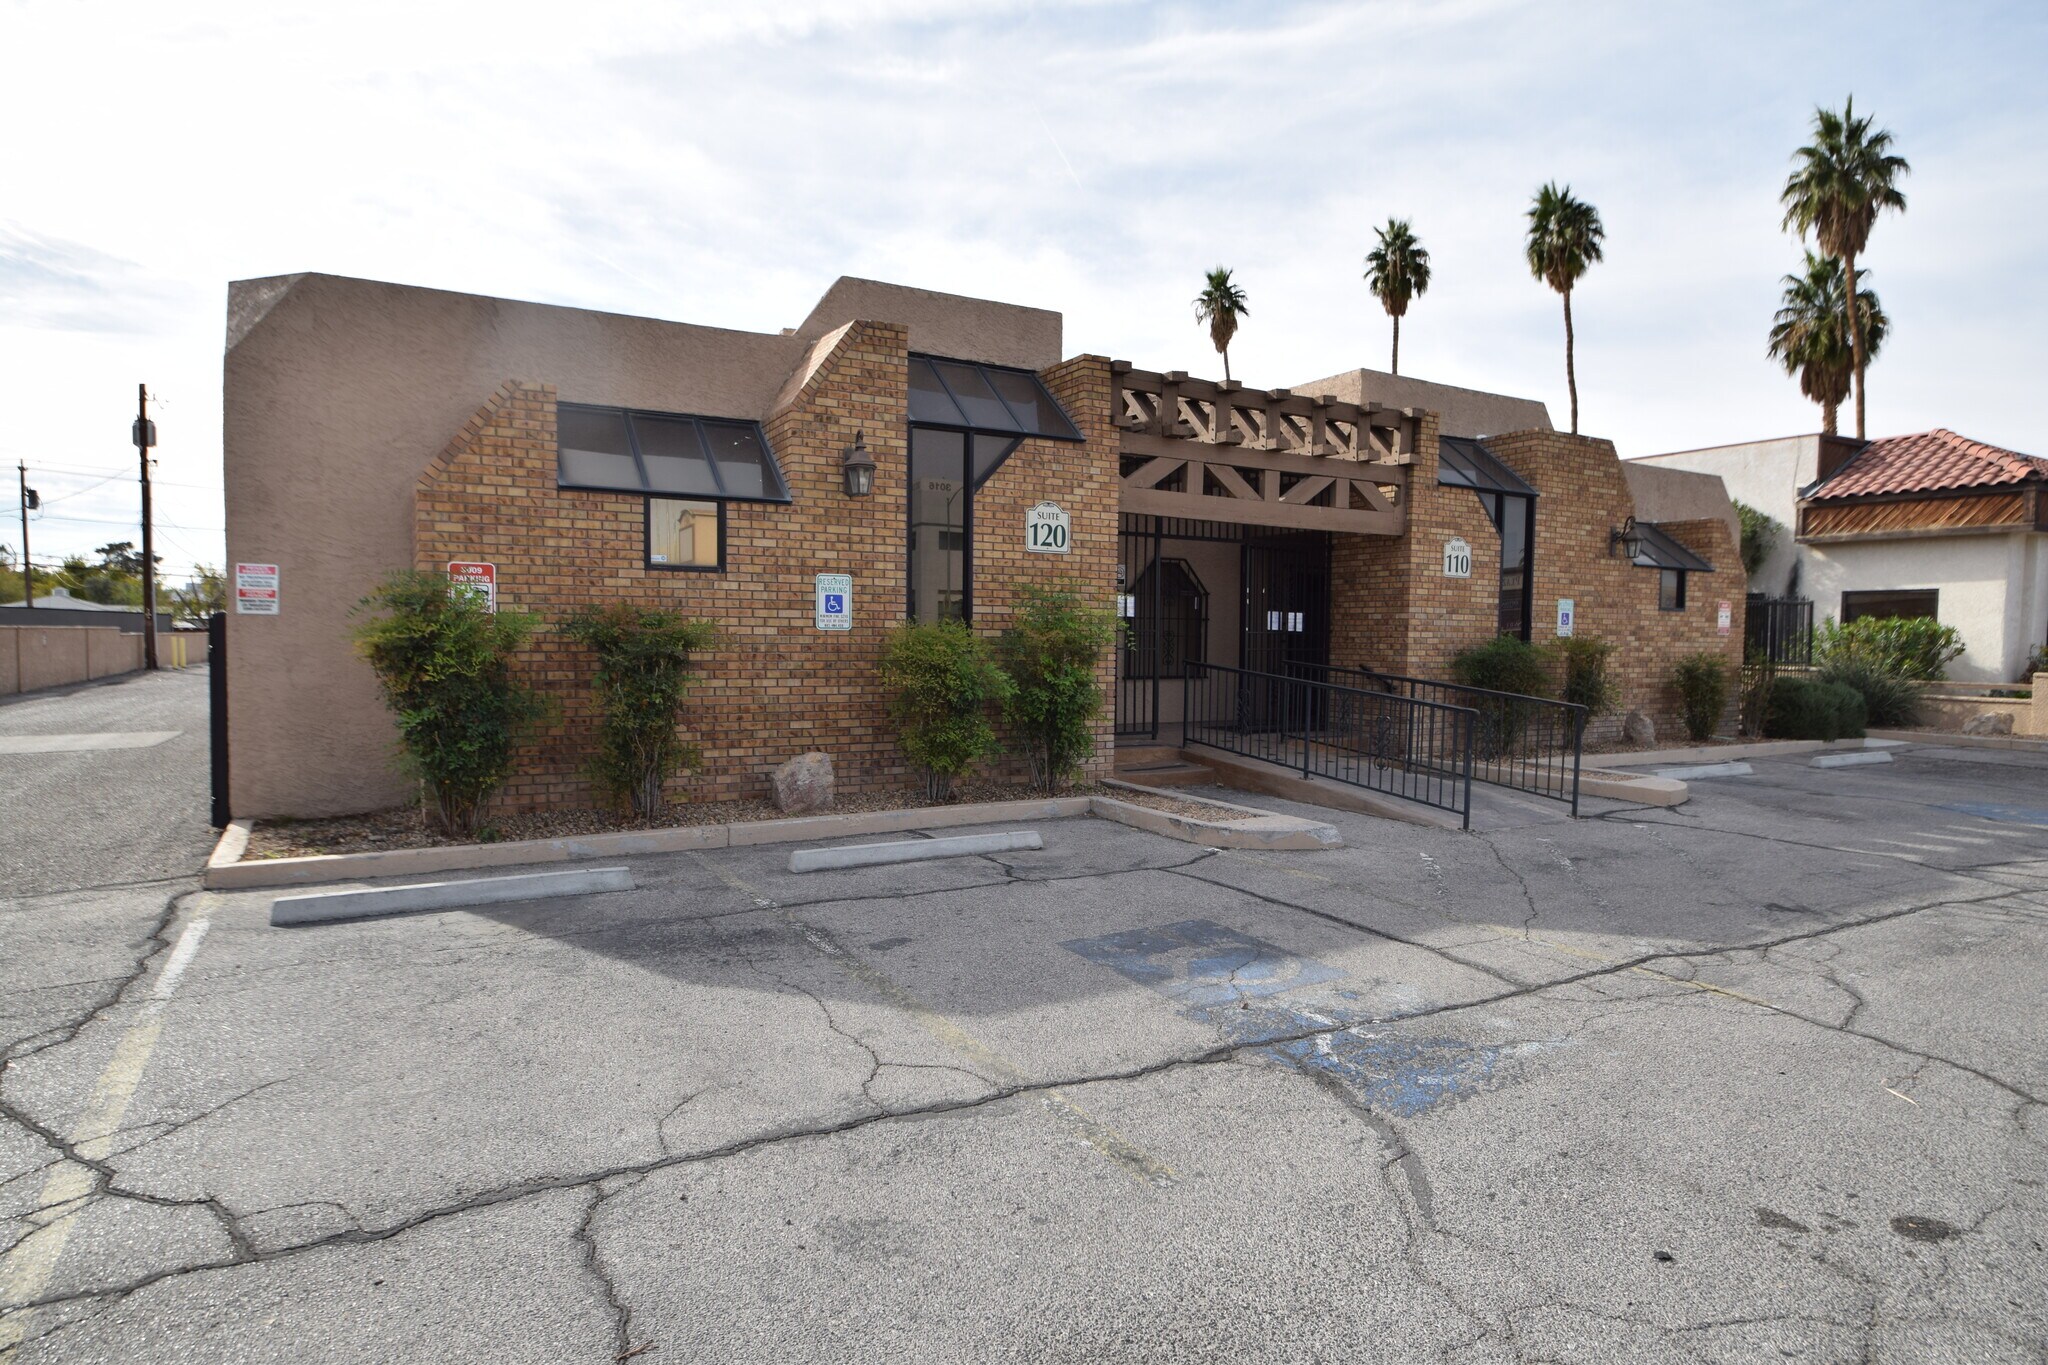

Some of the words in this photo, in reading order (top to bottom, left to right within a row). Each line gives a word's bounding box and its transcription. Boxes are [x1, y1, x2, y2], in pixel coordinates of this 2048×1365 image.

[1037, 512, 1060, 520] SUITE
[1030, 523, 1066, 548] 120
[1446, 554, 1469, 574] 110
[819, 578, 849, 586] RESERVED
